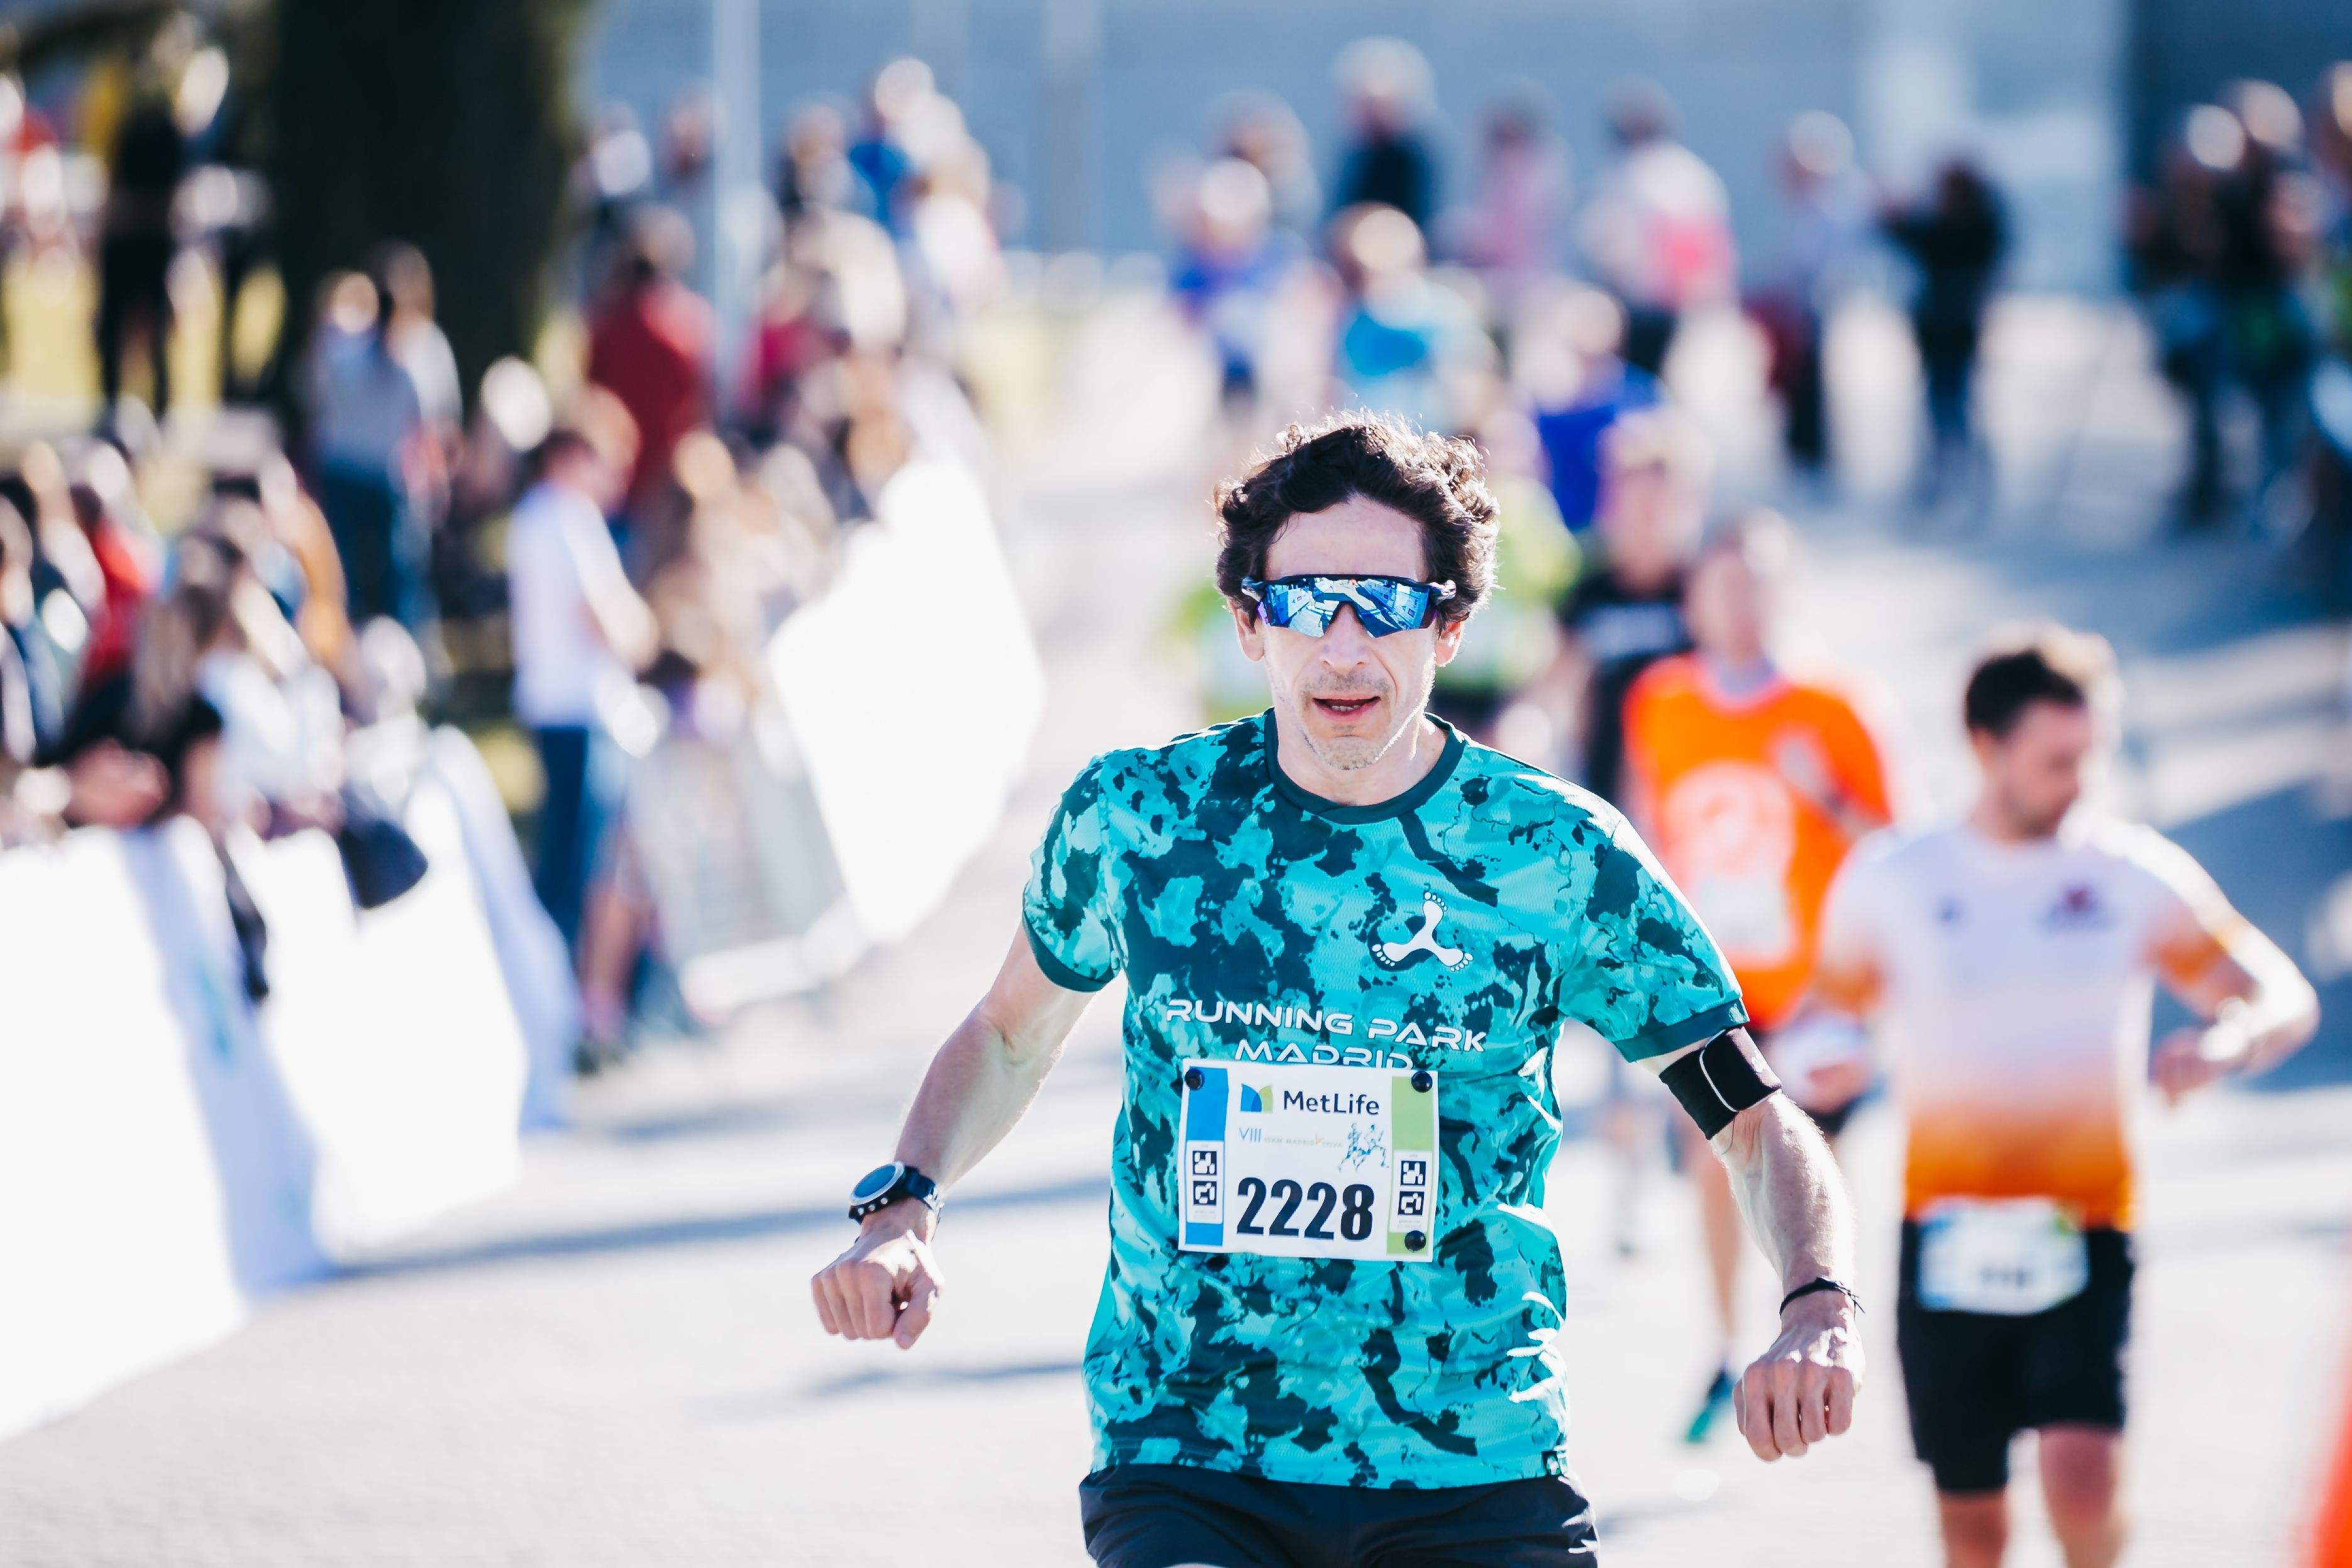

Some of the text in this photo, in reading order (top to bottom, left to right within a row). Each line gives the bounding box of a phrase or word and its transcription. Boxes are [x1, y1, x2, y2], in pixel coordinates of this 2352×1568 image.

[1166, 999, 1488, 1052] RUNNING PARK
[1234, 1039, 1414, 1070] MADRID
[1283, 1090, 1380, 1116] MetLife
[1239, 1127, 1262, 1143] VIII
[1236, 1176, 1375, 1242] 2228
